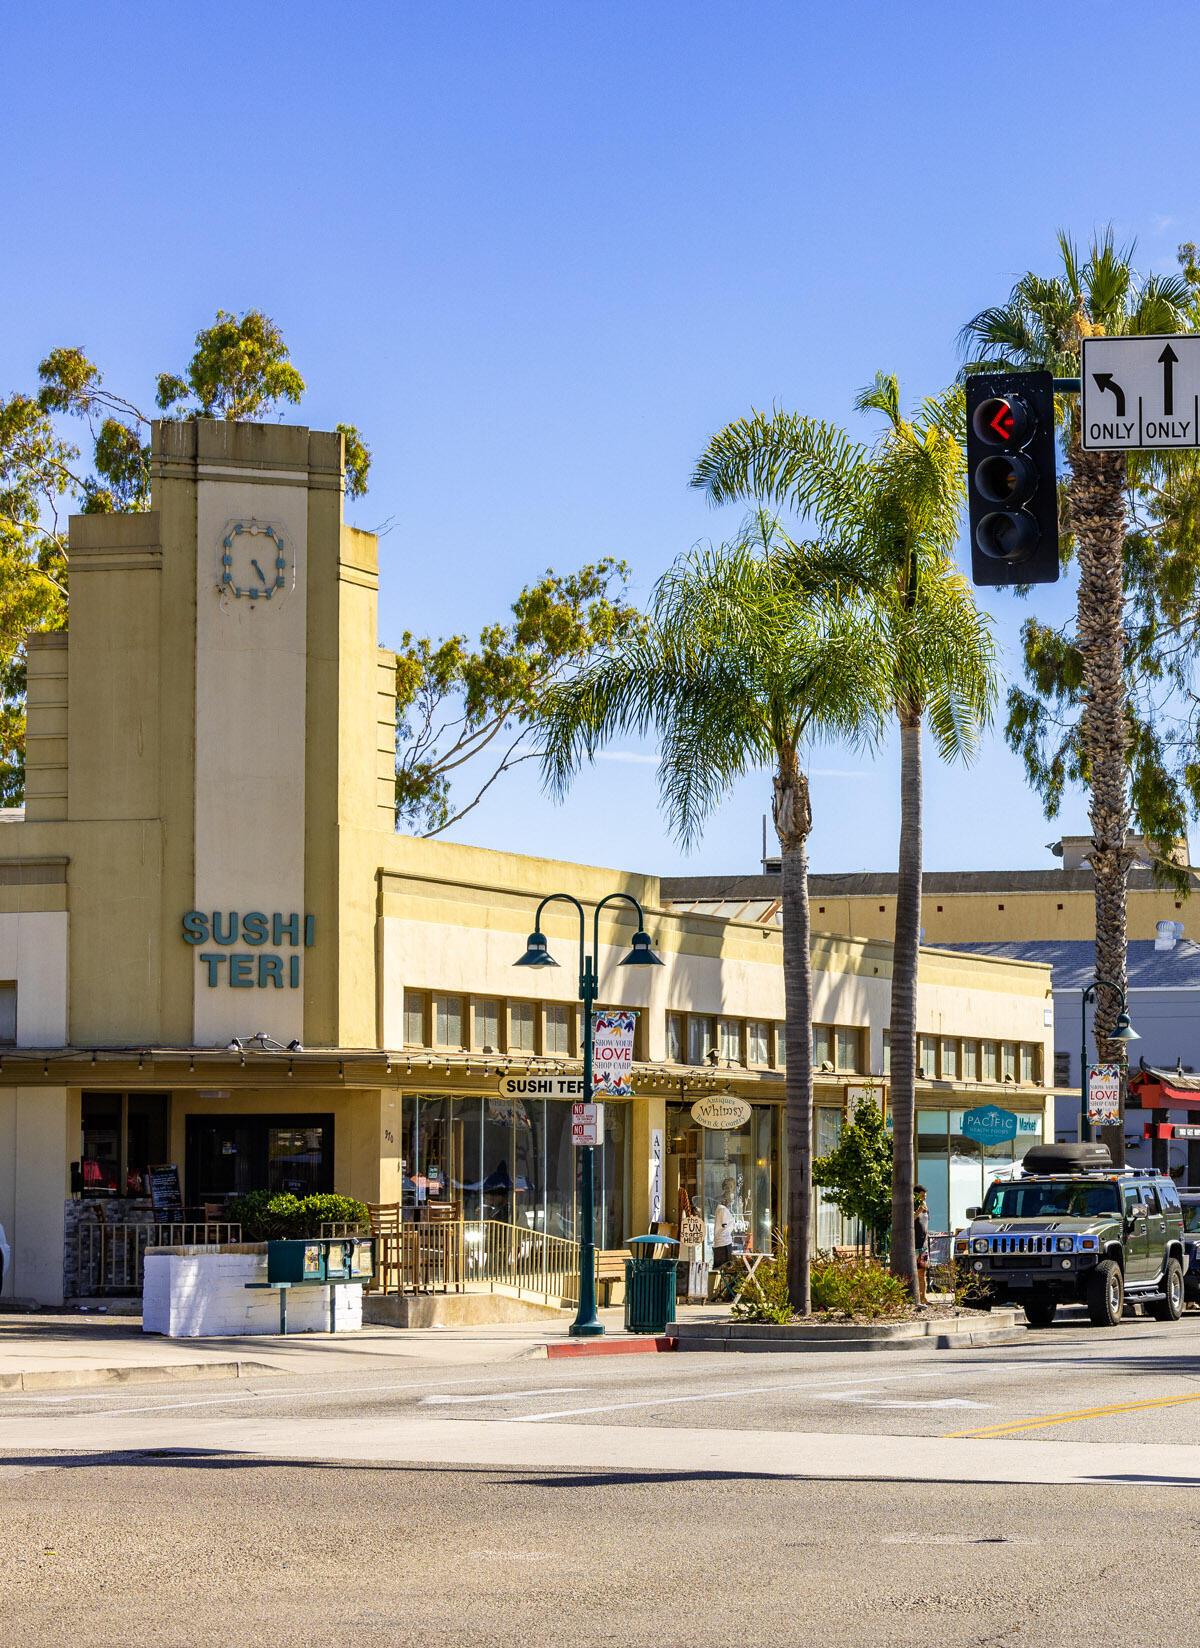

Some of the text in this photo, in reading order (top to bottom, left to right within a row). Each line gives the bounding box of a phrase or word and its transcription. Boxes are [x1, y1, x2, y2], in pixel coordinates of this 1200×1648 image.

[1090, 423, 1135, 440] ONLY
[1146, 421, 1191, 438] ONLY
[182, 911, 315, 947] SUSHI
[199, 953, 299, 988] TERI
[595, 1048, 631, 1060] LOVE
[506, 1080, 584, 1094] SUSHI TER
[706, 1097, 736, 1105] Antiques
[1090, 1090, 1118, 1100] LOVE
[574, 1104, 582, 1114] NO
[700, 1104, 744, 1117] Whimsy
[696, 1113, 711, 1125] Town
[720, 1116, 745, 1127] Country
[967, 1115, 1013, 1129] PACIFIC
[1019, 1117, 1037, 1131] Market
[574, 1126, 582, 1135] NO
[653, 1135, 661, 1222] ANTIQ
[682, 1223, 702, 1232] FUN
